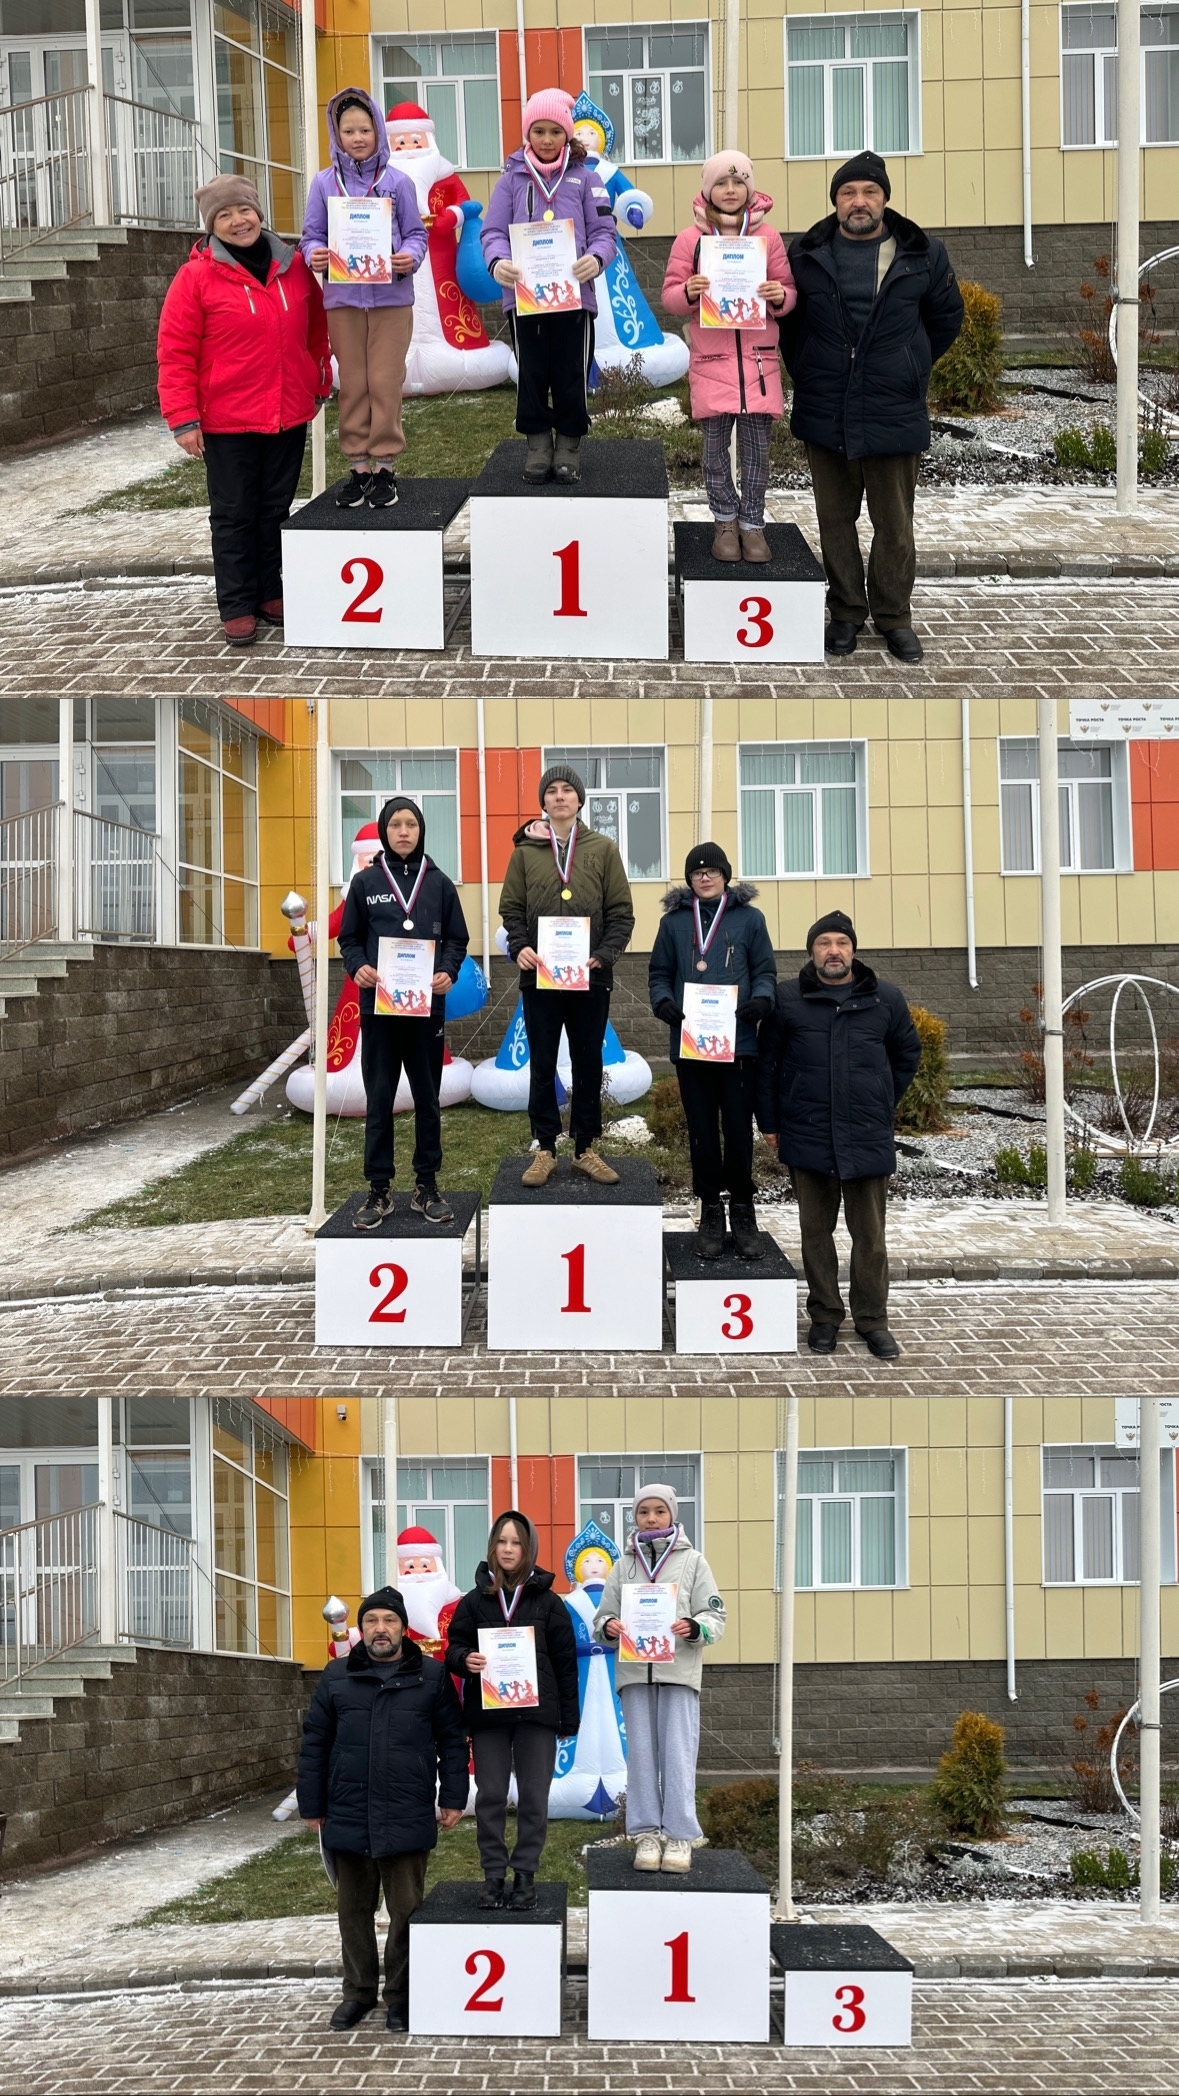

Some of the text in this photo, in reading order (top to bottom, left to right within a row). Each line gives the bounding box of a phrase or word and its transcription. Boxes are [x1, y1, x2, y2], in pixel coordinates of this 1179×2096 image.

[341, 557, 384, 623] 2
[553, 541, 587, 616] 1
[737, 597, 773, 647] 3
[366, 893, 397, 905] NASA
[370, 1264, 408, 1323] 2
[562, 1244, 590, 1312] 1
[722, 1294, 753, 1339] 3
[465, 1949, 505, 2011] 2
[665, 1932, 694, 2002] 1
[833, 1985, 865, 2032] 3
